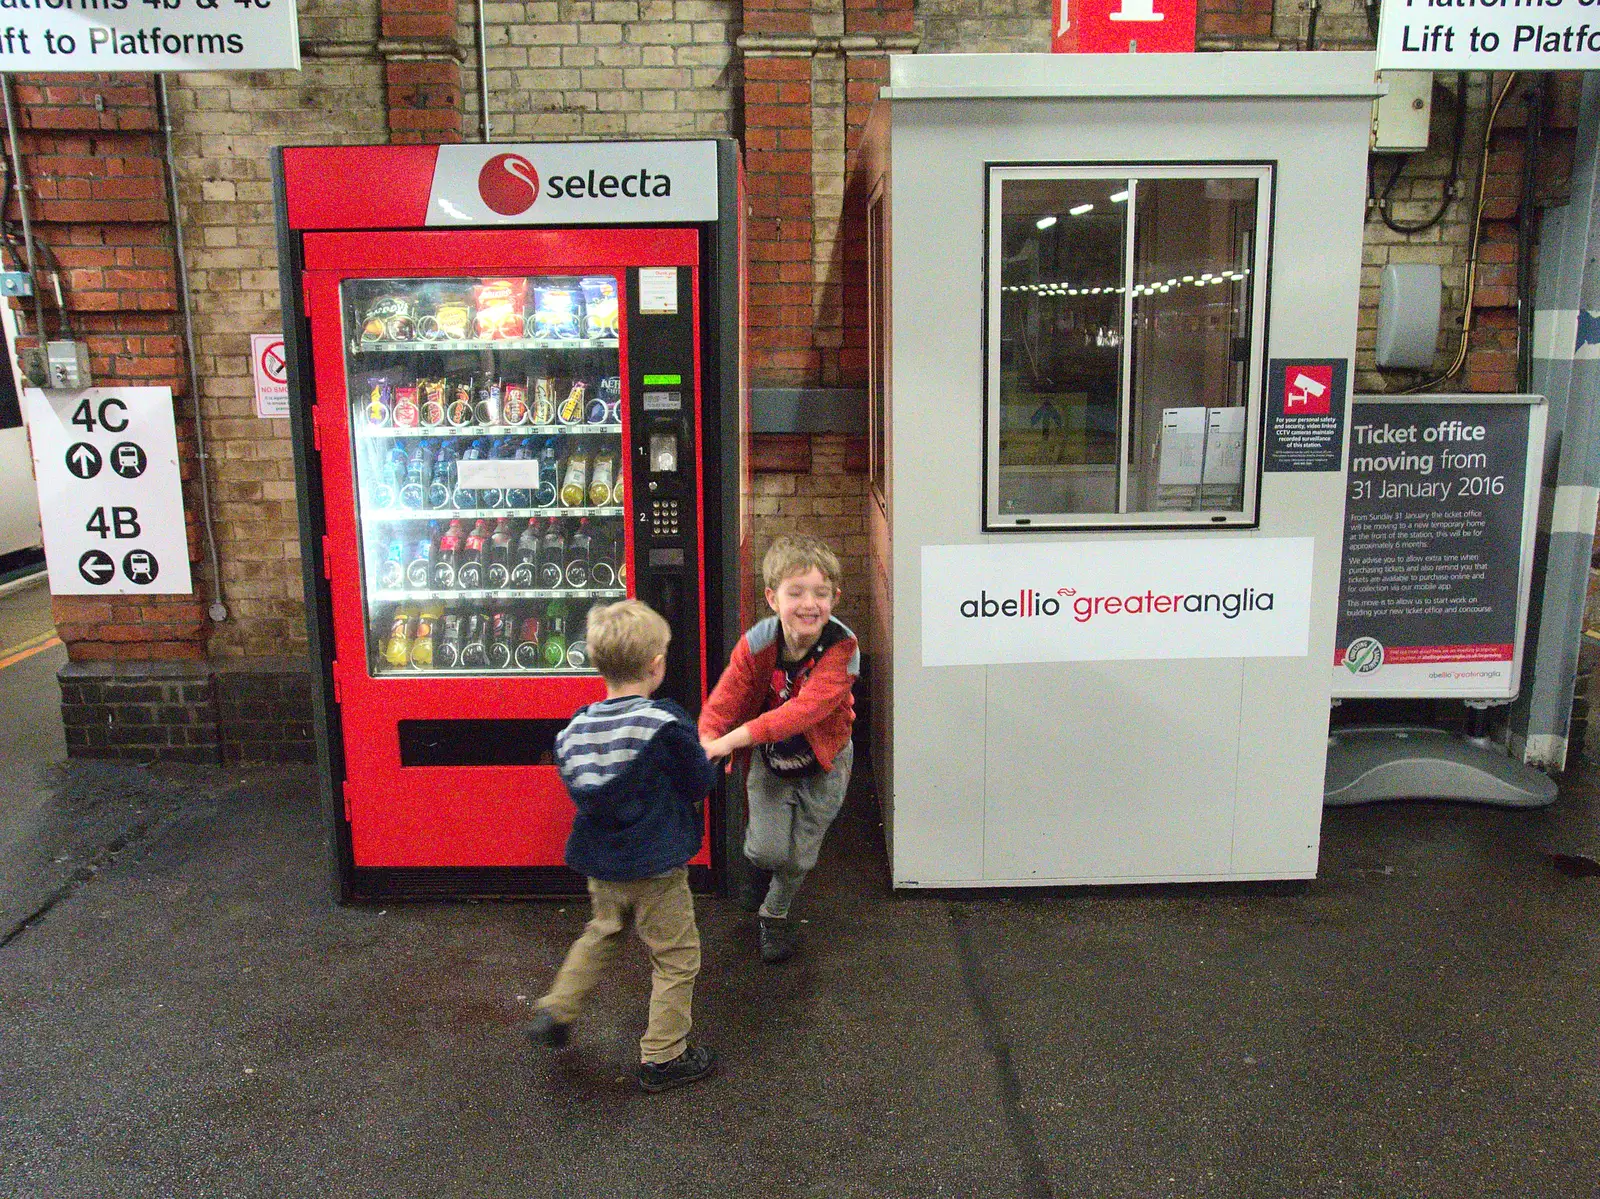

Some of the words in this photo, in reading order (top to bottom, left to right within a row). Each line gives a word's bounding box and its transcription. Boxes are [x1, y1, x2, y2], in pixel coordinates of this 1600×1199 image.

[44, 28, 76, 54] to
[89, 27, 244, 54] Platforms
[1402, 25, 1455, 52] Lift
[1470, 26, 1500, 52] to
[546, 169, 670, 198] selecta
[72, 398, 129, 432] 4C
[1354, 423, 1417, 444] Ticket
[1423, 421, 1486, 442] office
[1353, 451, 1433, 475] moving
[1441, 449, 1486, 469] from
[1352, 480, 1371, 499] 31
[1379, 480, 1451, 501] January
[1458, 476, 1504, 496] 2016
[86, 506, 141, 539] 4B
[960, 589, 1060, 618] abellio
[1073, 588, 1274, 623] greateranglia
